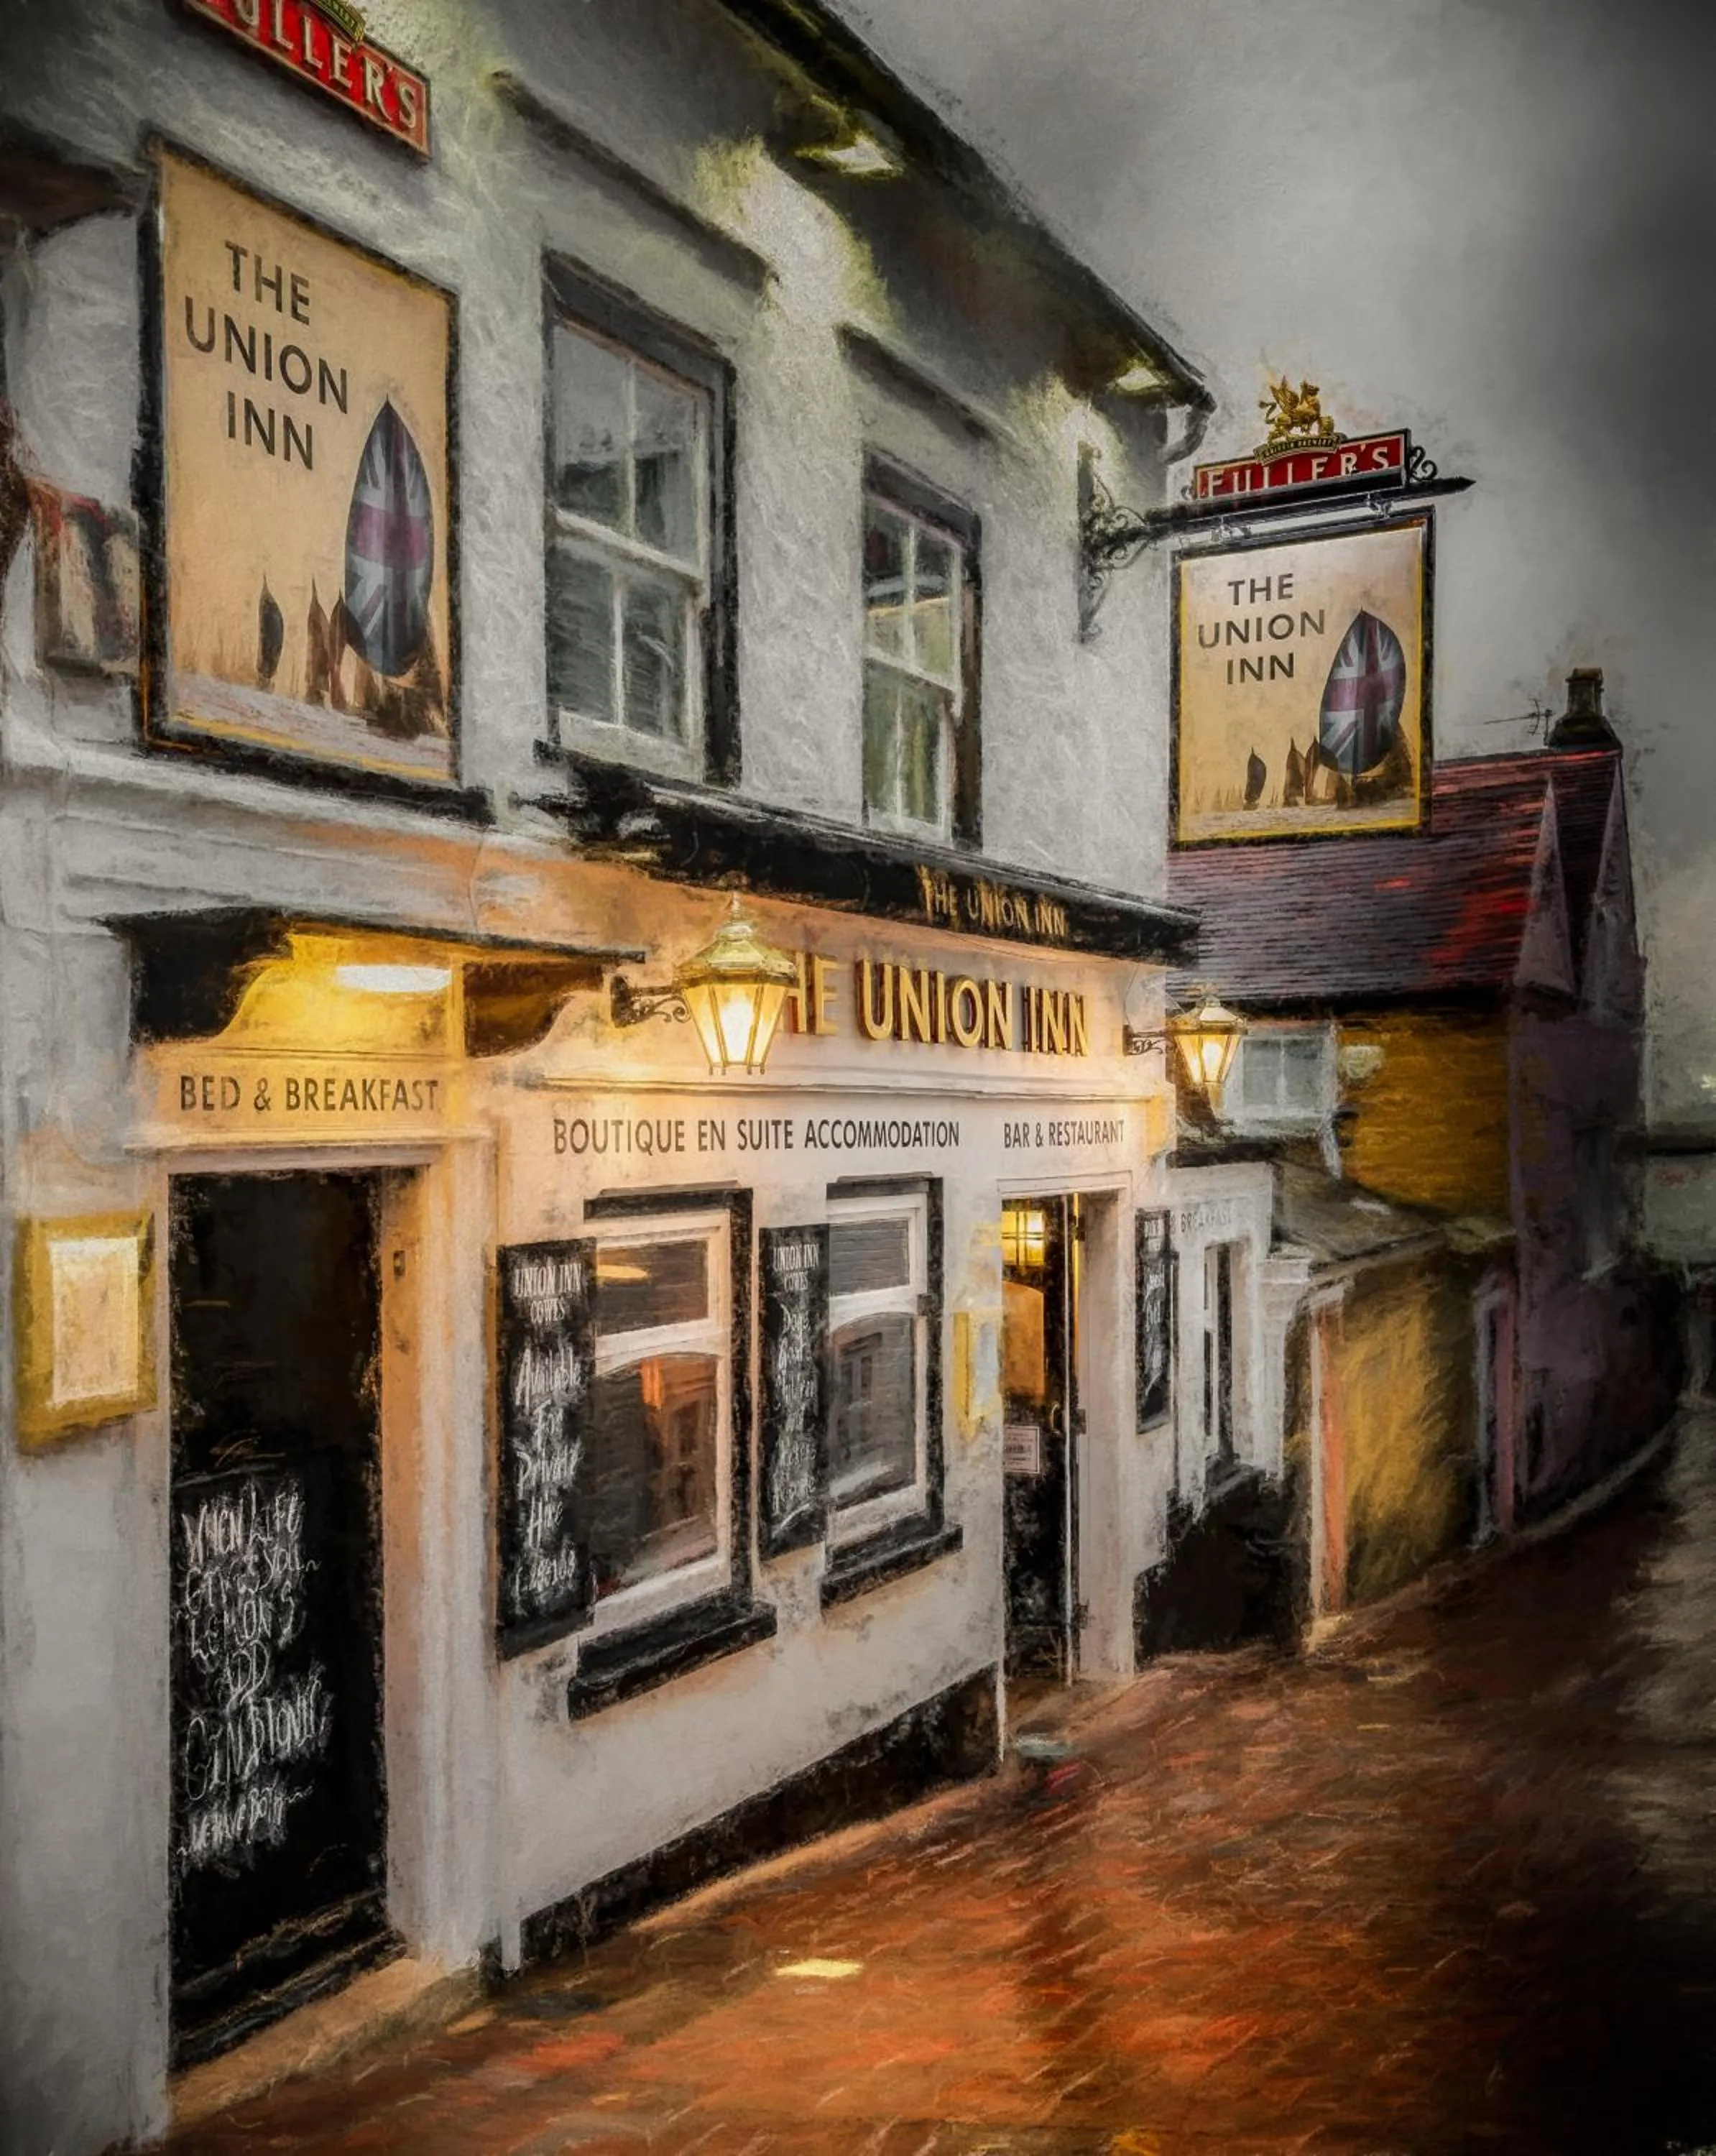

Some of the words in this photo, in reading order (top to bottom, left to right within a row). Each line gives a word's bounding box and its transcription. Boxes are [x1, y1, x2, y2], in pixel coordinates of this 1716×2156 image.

[206, 0, 416, 129] ULLER'S
[225, 240, 310, 326] THE
[185, 295, 348, 415] UNION
[227, 390, 313, 471] INN
[1227, 573, 1294, 606] THE
[1198, 609, 1326, 648] UNION
[1227, 652, 1295, 685] INN
[918, 865, 959, 920] THE
[967, 881, 1030, 933] UNION
[1035, 896, 1066, 936] INN
[782, 950, 838, 1036] HE
[855, 959, 1013, 1051] UNION
[1024, 985, 1089, 1056] INN
[180, 1076, 241, 1111] BED
[253, 1080, 272, 1112] &
[286, 1077, 438, 1112] BREAKFAST
[553, 1118, 685, 1156] BOUTIQUE
[698, 1120, 726, 1151] EN
[737, 1118, 793, 1151] SUITE
[804, 1119, 959, 1149] ACCOMMODATION
[1005, 1122, 1030, 1148] BAR
[1035, 1123, 1044, 1147] &
[1048, 1119, 1125, 1147] RESTAURANT
[514, 1265, 557, 1297] UNION
[559, 1263, 581, 1292] INN
[772, 1245, 802, 1271] UNION
[803, 1243, 819, 1268] INN
[182, 1499, 244, 1565] WHEN
[185, 1710, 244, 1800] GIN
